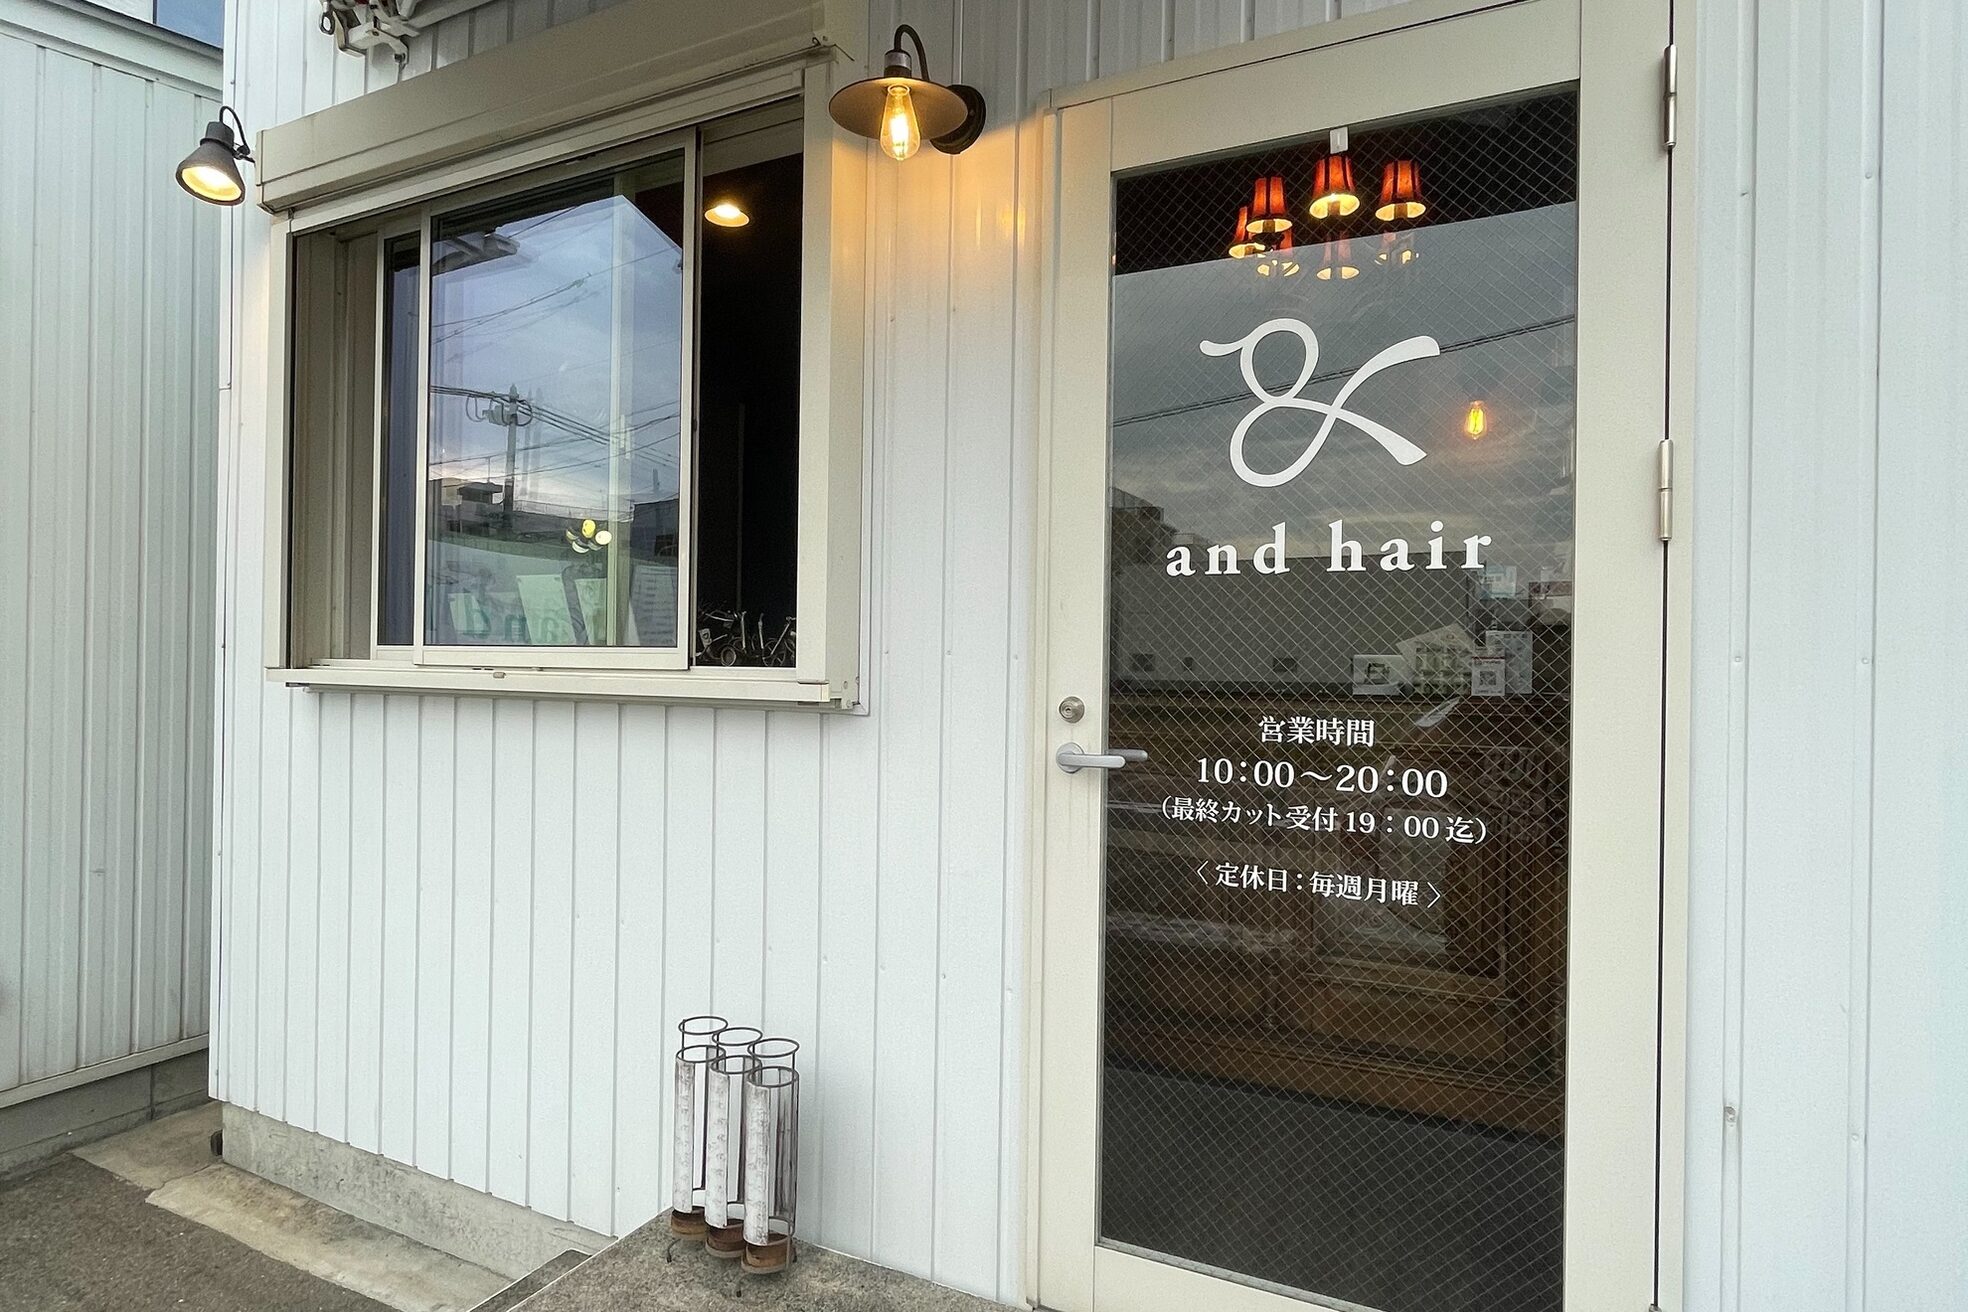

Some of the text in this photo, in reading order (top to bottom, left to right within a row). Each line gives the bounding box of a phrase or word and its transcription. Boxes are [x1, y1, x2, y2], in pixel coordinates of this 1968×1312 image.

[1166, 519, 1492, 577] and hair
[1258, 715, 1376, 747] 営業時間
